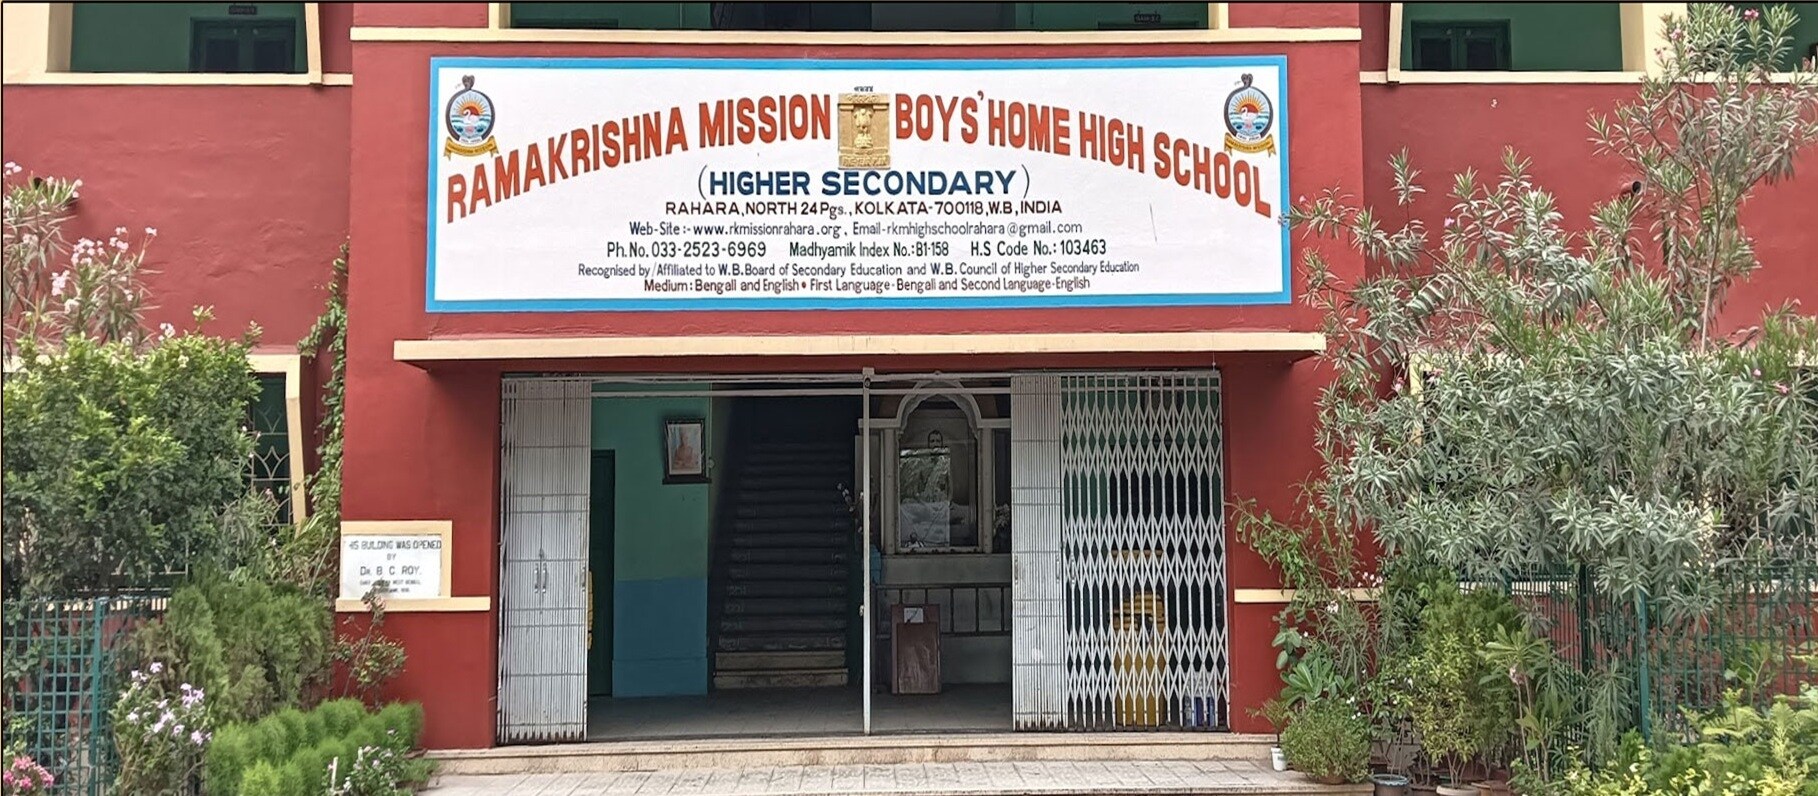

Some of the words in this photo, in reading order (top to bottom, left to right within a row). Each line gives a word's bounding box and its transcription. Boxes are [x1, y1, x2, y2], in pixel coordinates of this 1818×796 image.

[446, 106, 690, 224] RAMAKRISHNA
[698, 93, 831, 149] MISSION
[894, 90, 985, 145] BOYS'
[987, 98, 1071, 156] HOME
[1078, 111, 1145, 174] HIGH
[1153, 131, 1272, 219] SCHOOL
[651, 240, 767, 258] 033-2523-6969
[789, 241, 857, 260] Madhyamik
[859, 241, 890, 257] Index
[970, 240, 991, 257] H.S
[997, 240, 1028, 257] Code
[1059, 238, 1107, 255] 103463
[578, 263, 636, 279] Recognised
[705, 263, 716, 276] to
[778, 262, 790, 277] of
[791, 262, 847, 278] Secondary
[850, 262, 903, 276] Education
[906, 262, 927, 275] and
[959, 261, 997, 275] Council
[1000, 261, 1012, 275] of
[1014, 261, 1048, 279] Higher
[1050, 260, 1098, 275] Secondary
[1099, 260, 1140, 273] Education
[740, 278, 761, 292] and
[762, 278, 800, 295] English
[809, 278, 833, 292] First
[938, 277, 958, 291] and
[960, 276, 1001, 291] Second
[361, 540, 394, 550] BUILDING
[396, 540, 411, 549] WAS
[412, 539, 442, 550] OPENED
